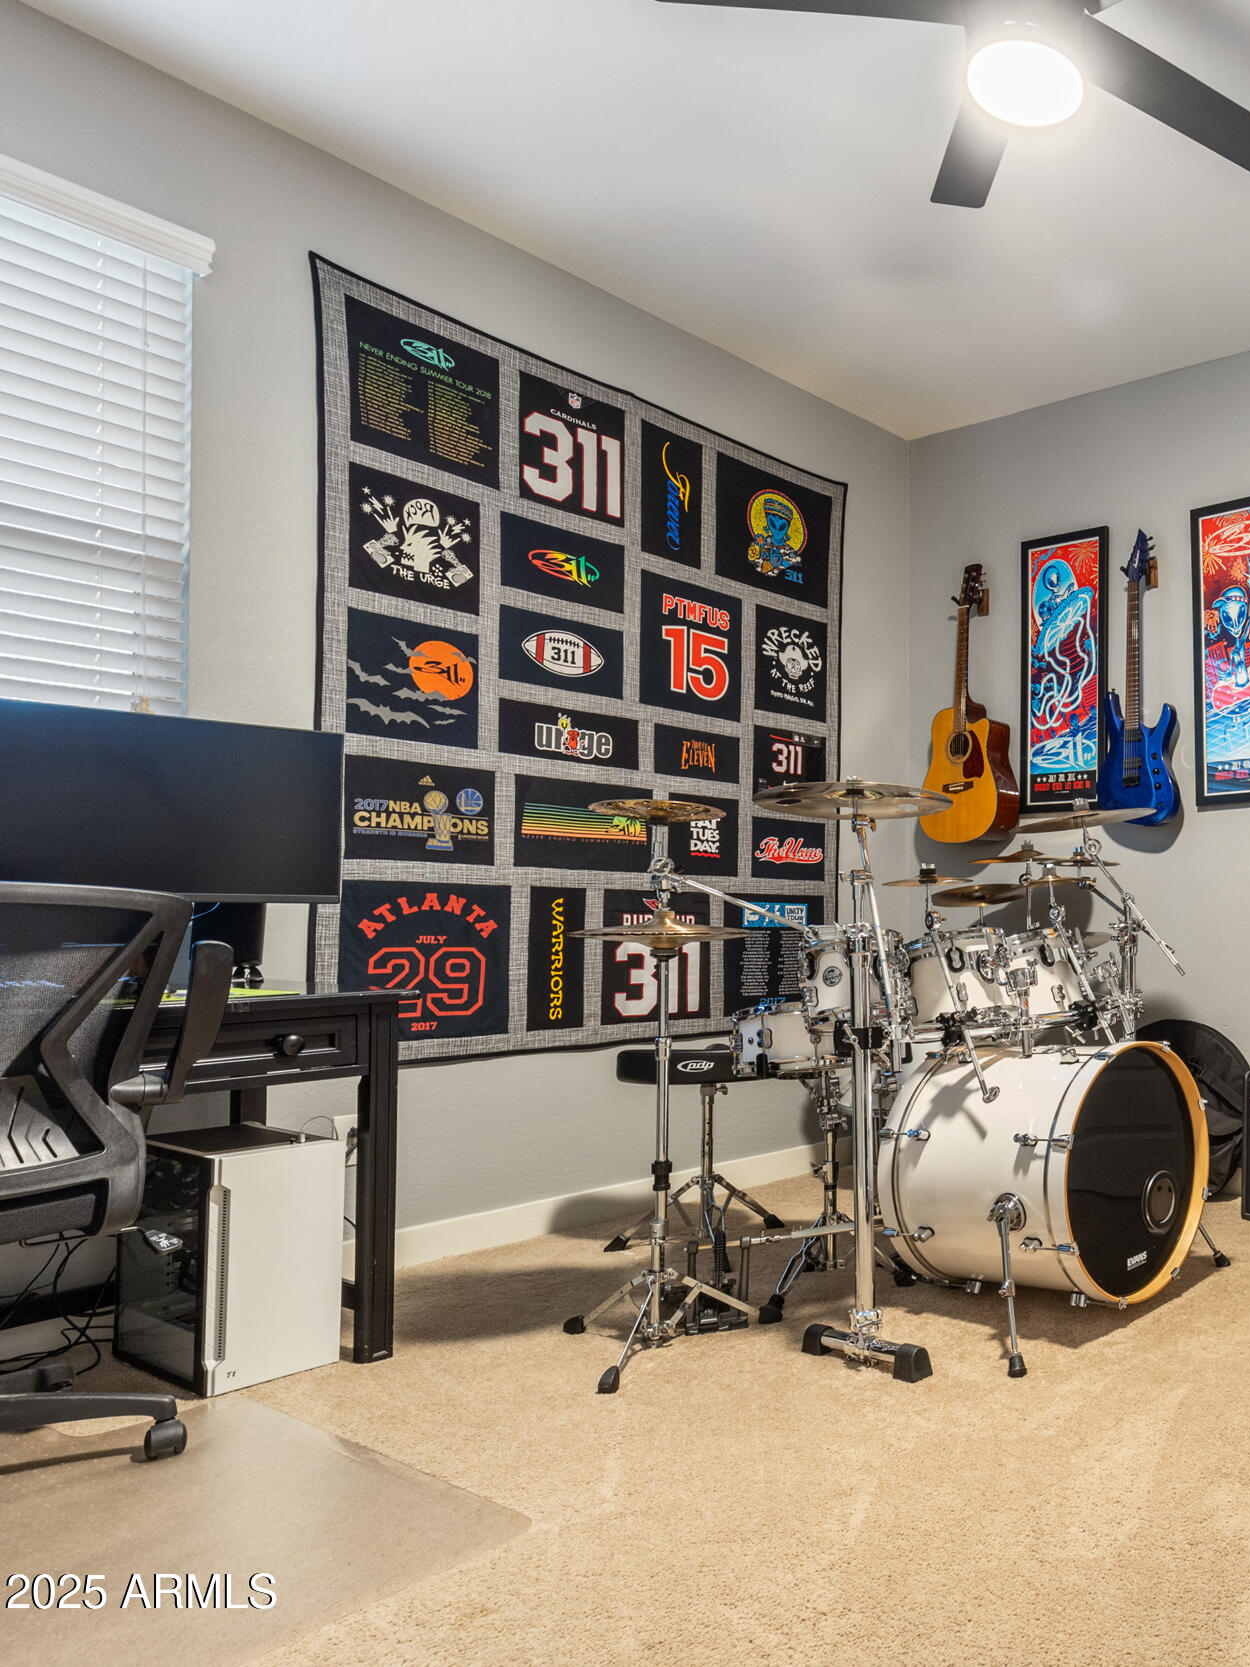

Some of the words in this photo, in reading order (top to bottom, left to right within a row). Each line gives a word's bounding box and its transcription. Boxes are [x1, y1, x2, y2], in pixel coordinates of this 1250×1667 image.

[359, 341, 384, 357] NEVER
[386, 352, 418, 371] ENDING
[420, 366, 453, 384] SUMMER
[455, 379, 474, 393] TOUR
[550, 409, 597, 430] CARDINALS
[522, 411, 621, 519] 311
[391, 564, 415, 581] THE
[420, 572, 451, 590] URGE
[784, 568, 804, 585] 311
[662, 593, 731, 631] PTMFUS
[551, 646, 577, 665] 311
[661, 625, 730, 701] 15
[762, 626, 822, 672] WRECKED
[782, 678, 796, 693] THE
[798, 677, 815, 693] REEF
[681, 740, 716, 773] ELEVEN
[771, 742, 803, 775] 311
[354, 797, 389, 811] 2017
[388, 800, 422, 814] NBA
[690, 828, 720, 841] TUES
[358, 892, 498, 940] ATLANTA
[415, 935, 448, 944] JULY
[549, 897, 564, 1021] WARRIORS
[367, 947, 486, 1017] 29
[411, 1021, 438, 1031] 2017
[1127, 1250, 1148, 1267] EVANS
